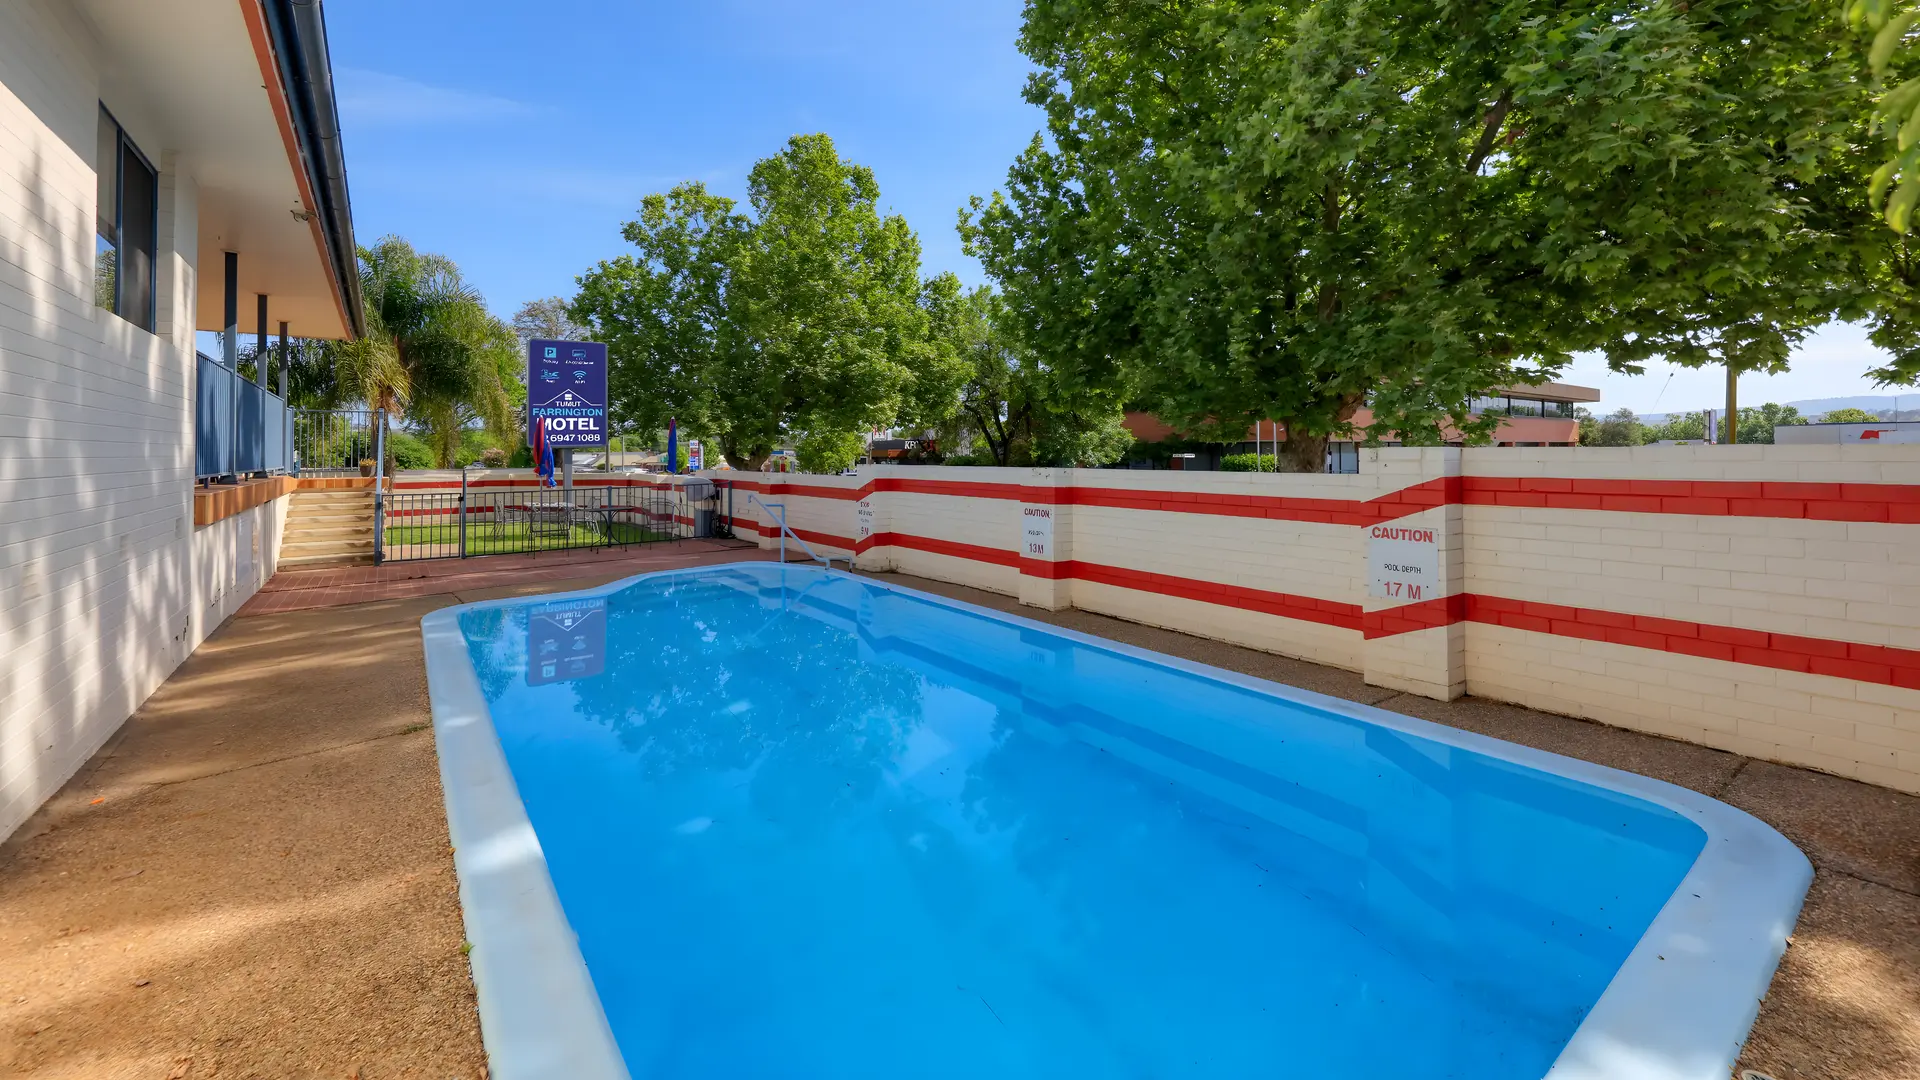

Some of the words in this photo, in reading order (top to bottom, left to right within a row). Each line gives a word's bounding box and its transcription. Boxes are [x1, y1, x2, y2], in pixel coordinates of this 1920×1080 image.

[532, 408, 603, 416] FARRINGTON
[550, 434, 575, 442] 6947
[577, 433, 600, 441] 1088
[1024, 507, 1050, 519] CAUTION
[1371, 526, 1433, 543] CAUTION
[1384, 563, 1400, 572] POOL
[1401, 565, 1421, 574] DEPTH
[1407, 584, 1421, 600] M
